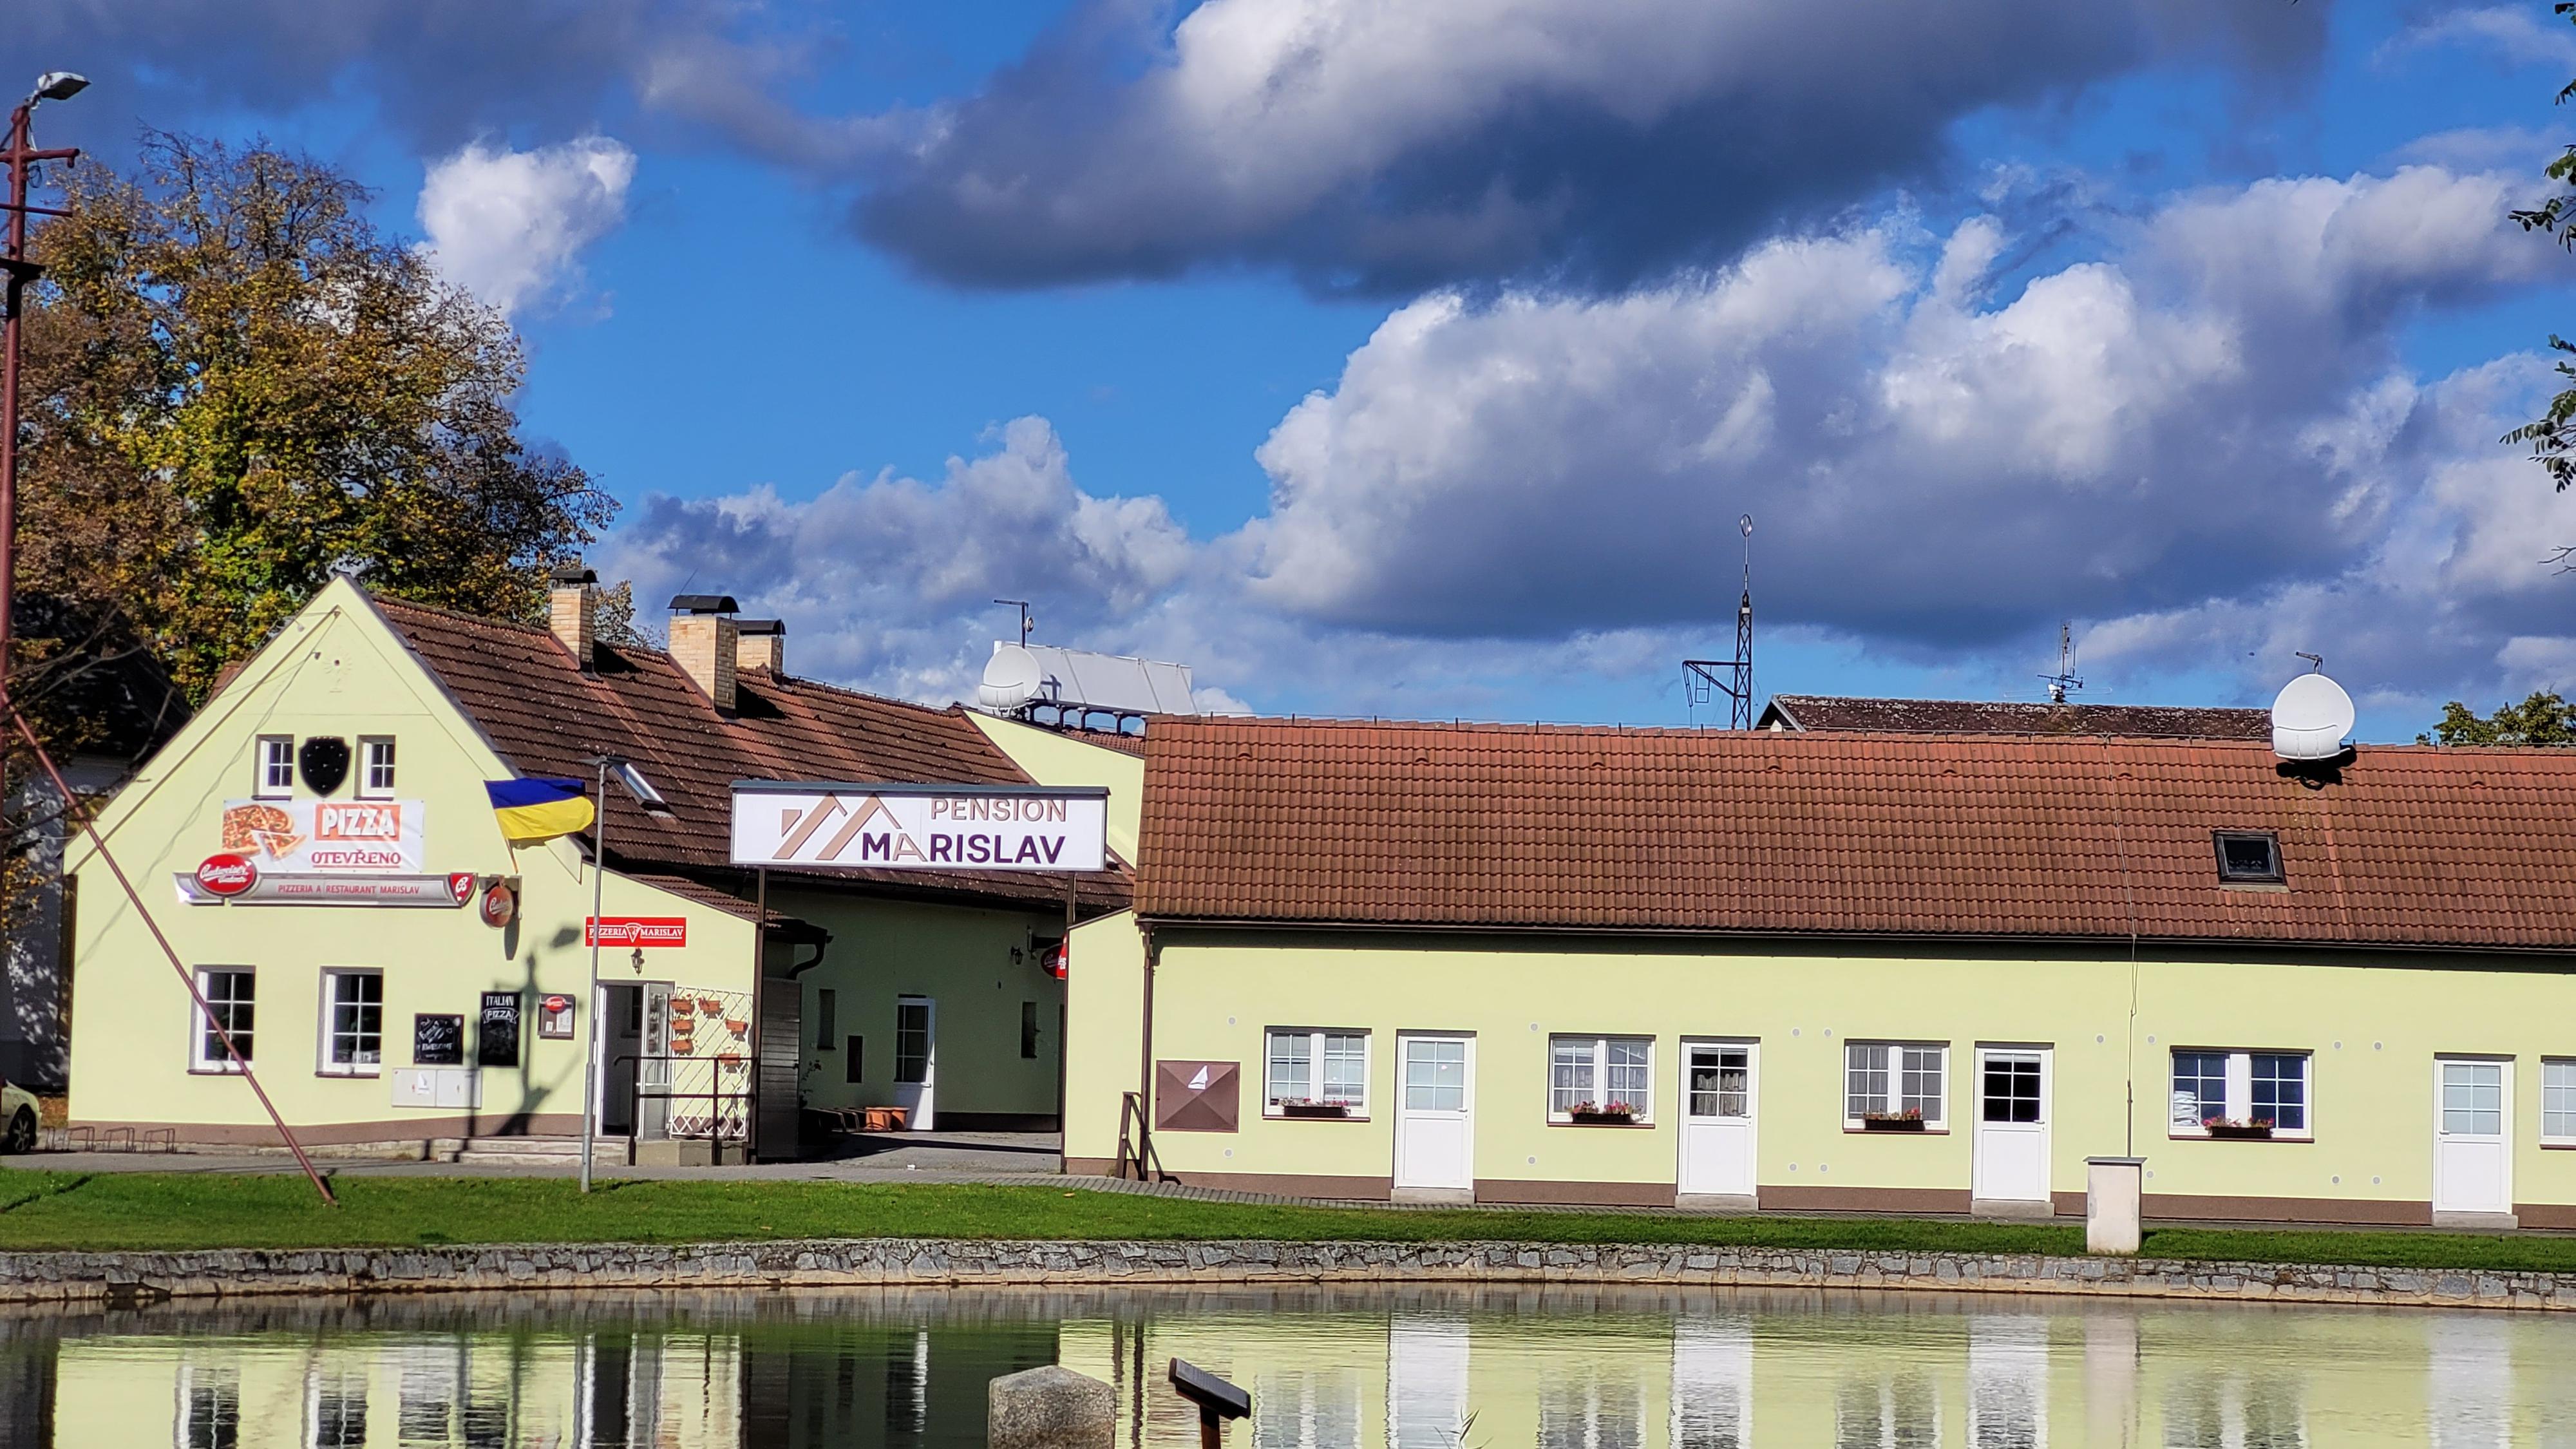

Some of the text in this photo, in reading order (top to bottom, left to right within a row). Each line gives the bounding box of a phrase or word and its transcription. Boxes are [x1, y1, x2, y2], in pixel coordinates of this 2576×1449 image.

[931, 798, 1066, 822] PENSION
[323, 808, 396, 837] PIZZA
[862, 832, 1066, 864] MARISLAV
[311, 849, 401, 864] OTEVŘENO
[326, 886, 376, 894] RESTAURANT
[640, 928, 683, 936] MARISLAV
[486, 995, 515, 1006] ITALIAN
[488, 1010, 512, 1018] PIZZA
